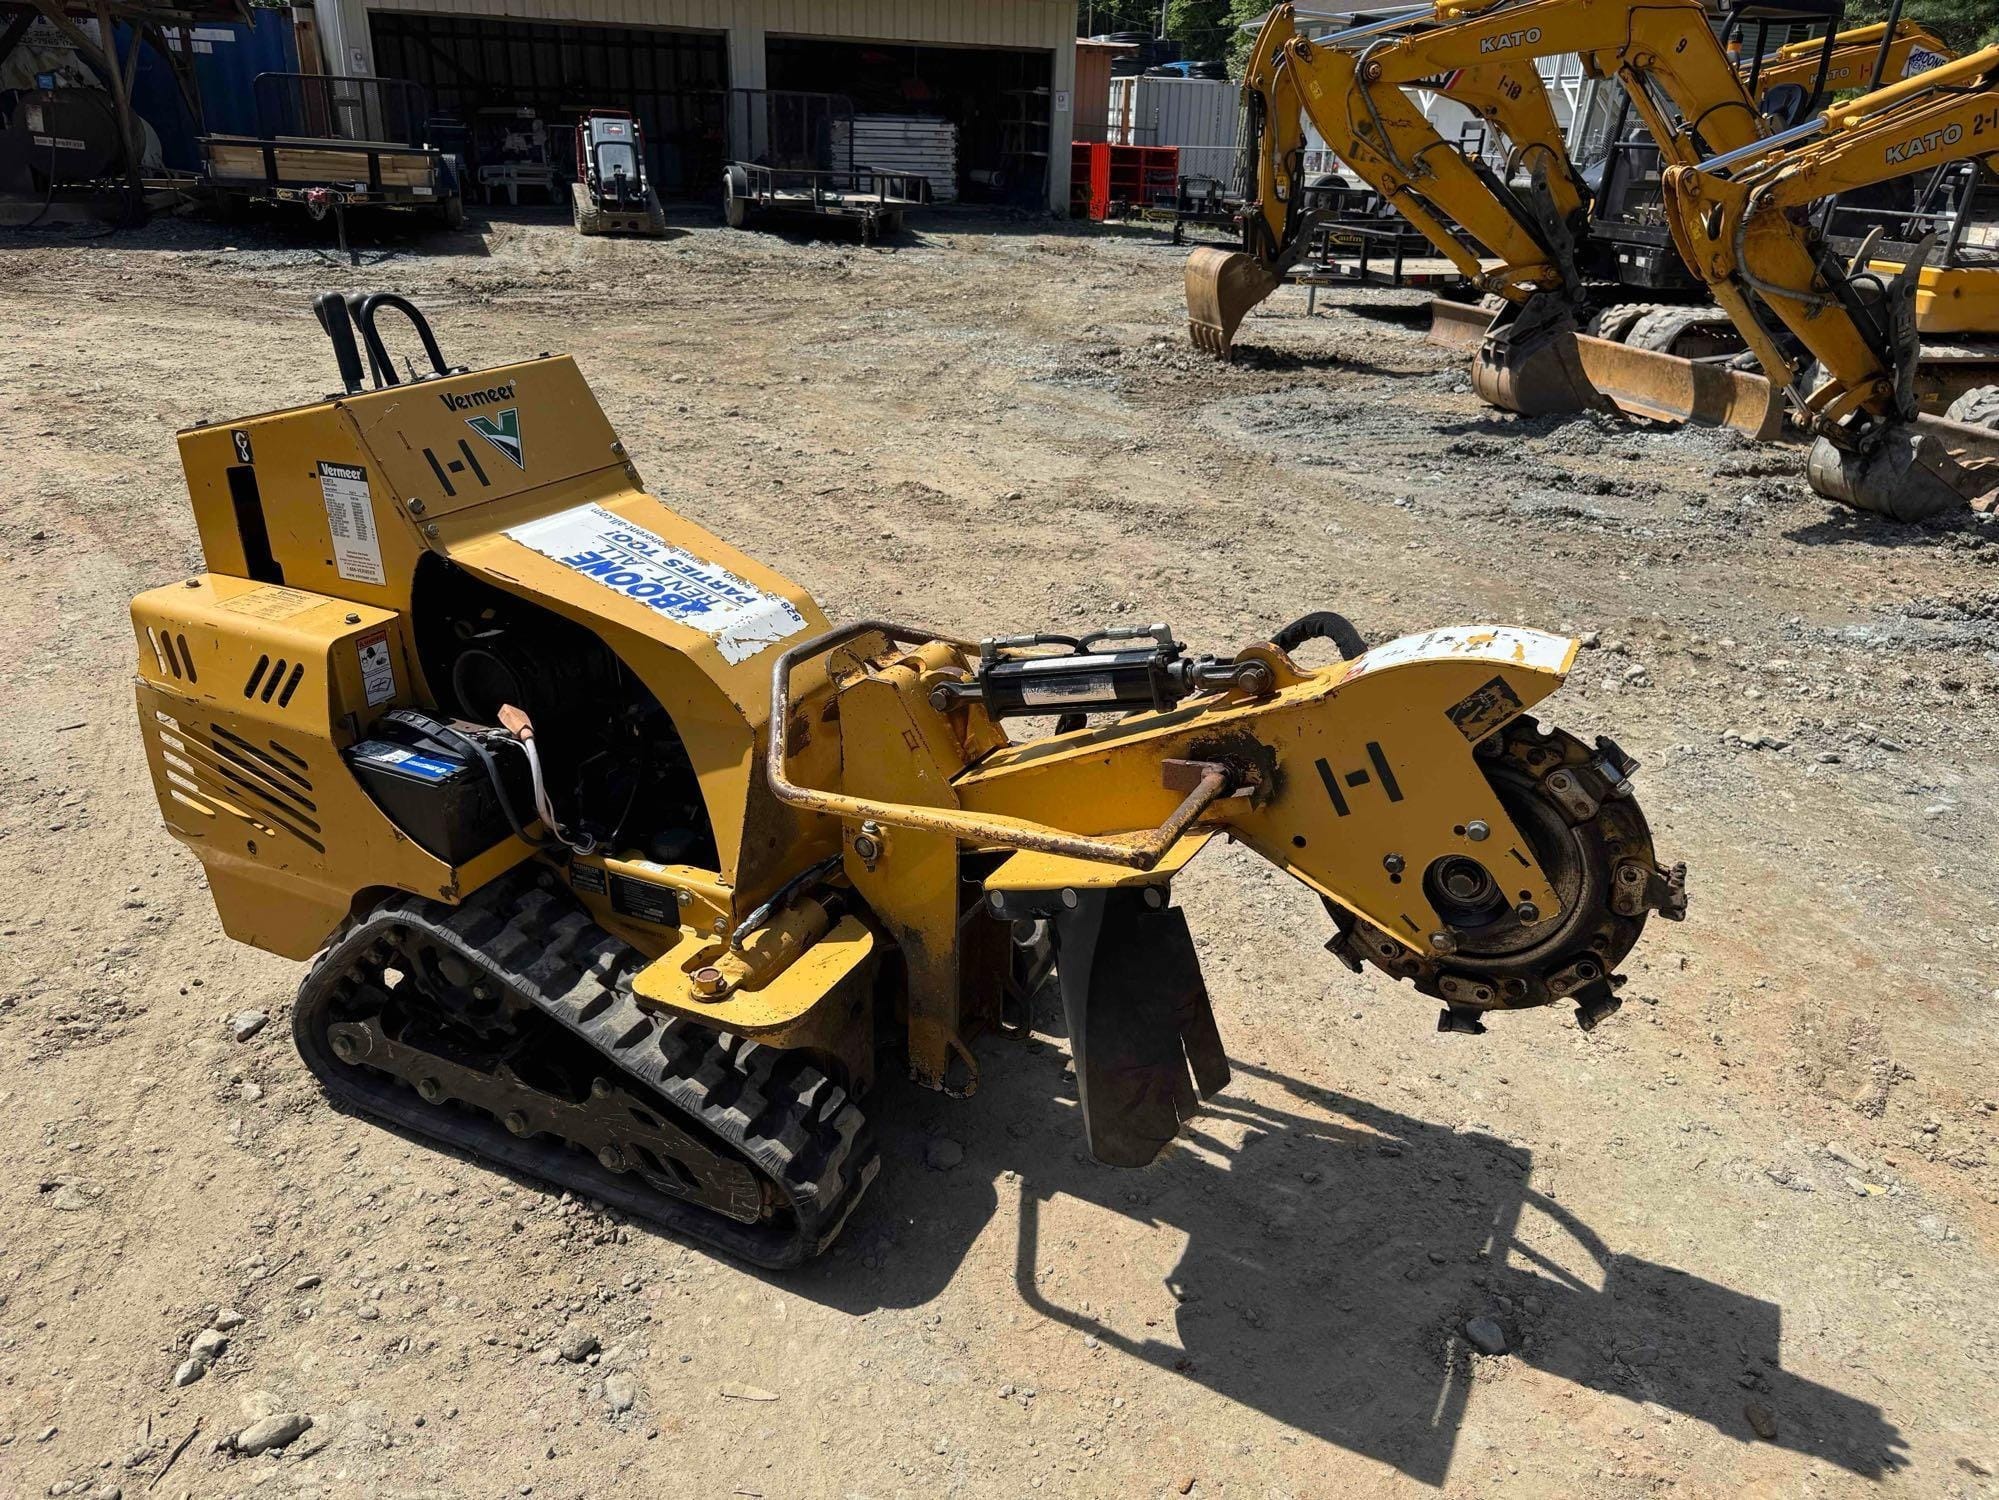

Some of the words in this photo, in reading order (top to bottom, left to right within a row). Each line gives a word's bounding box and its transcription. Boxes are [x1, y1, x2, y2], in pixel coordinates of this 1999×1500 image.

[1480, 27, 1542, 54] KATO
[1497, 75, 1522, 100] 1-18
[1885, 123, 1963, 164] KATO
[1329, 231, 1362, 245] Kaufm
[439, 384, 516, 412] Vermeer
[320, 462, 361, 480] Vermeer
[598, 544, 645, 566] ALL
[605, 530, 660, 557] TOO!
[560, 551, 692, 609] BOONE
[650, 575, 721, 606] RENT
[662, 558, 758, 604] PARTIES
